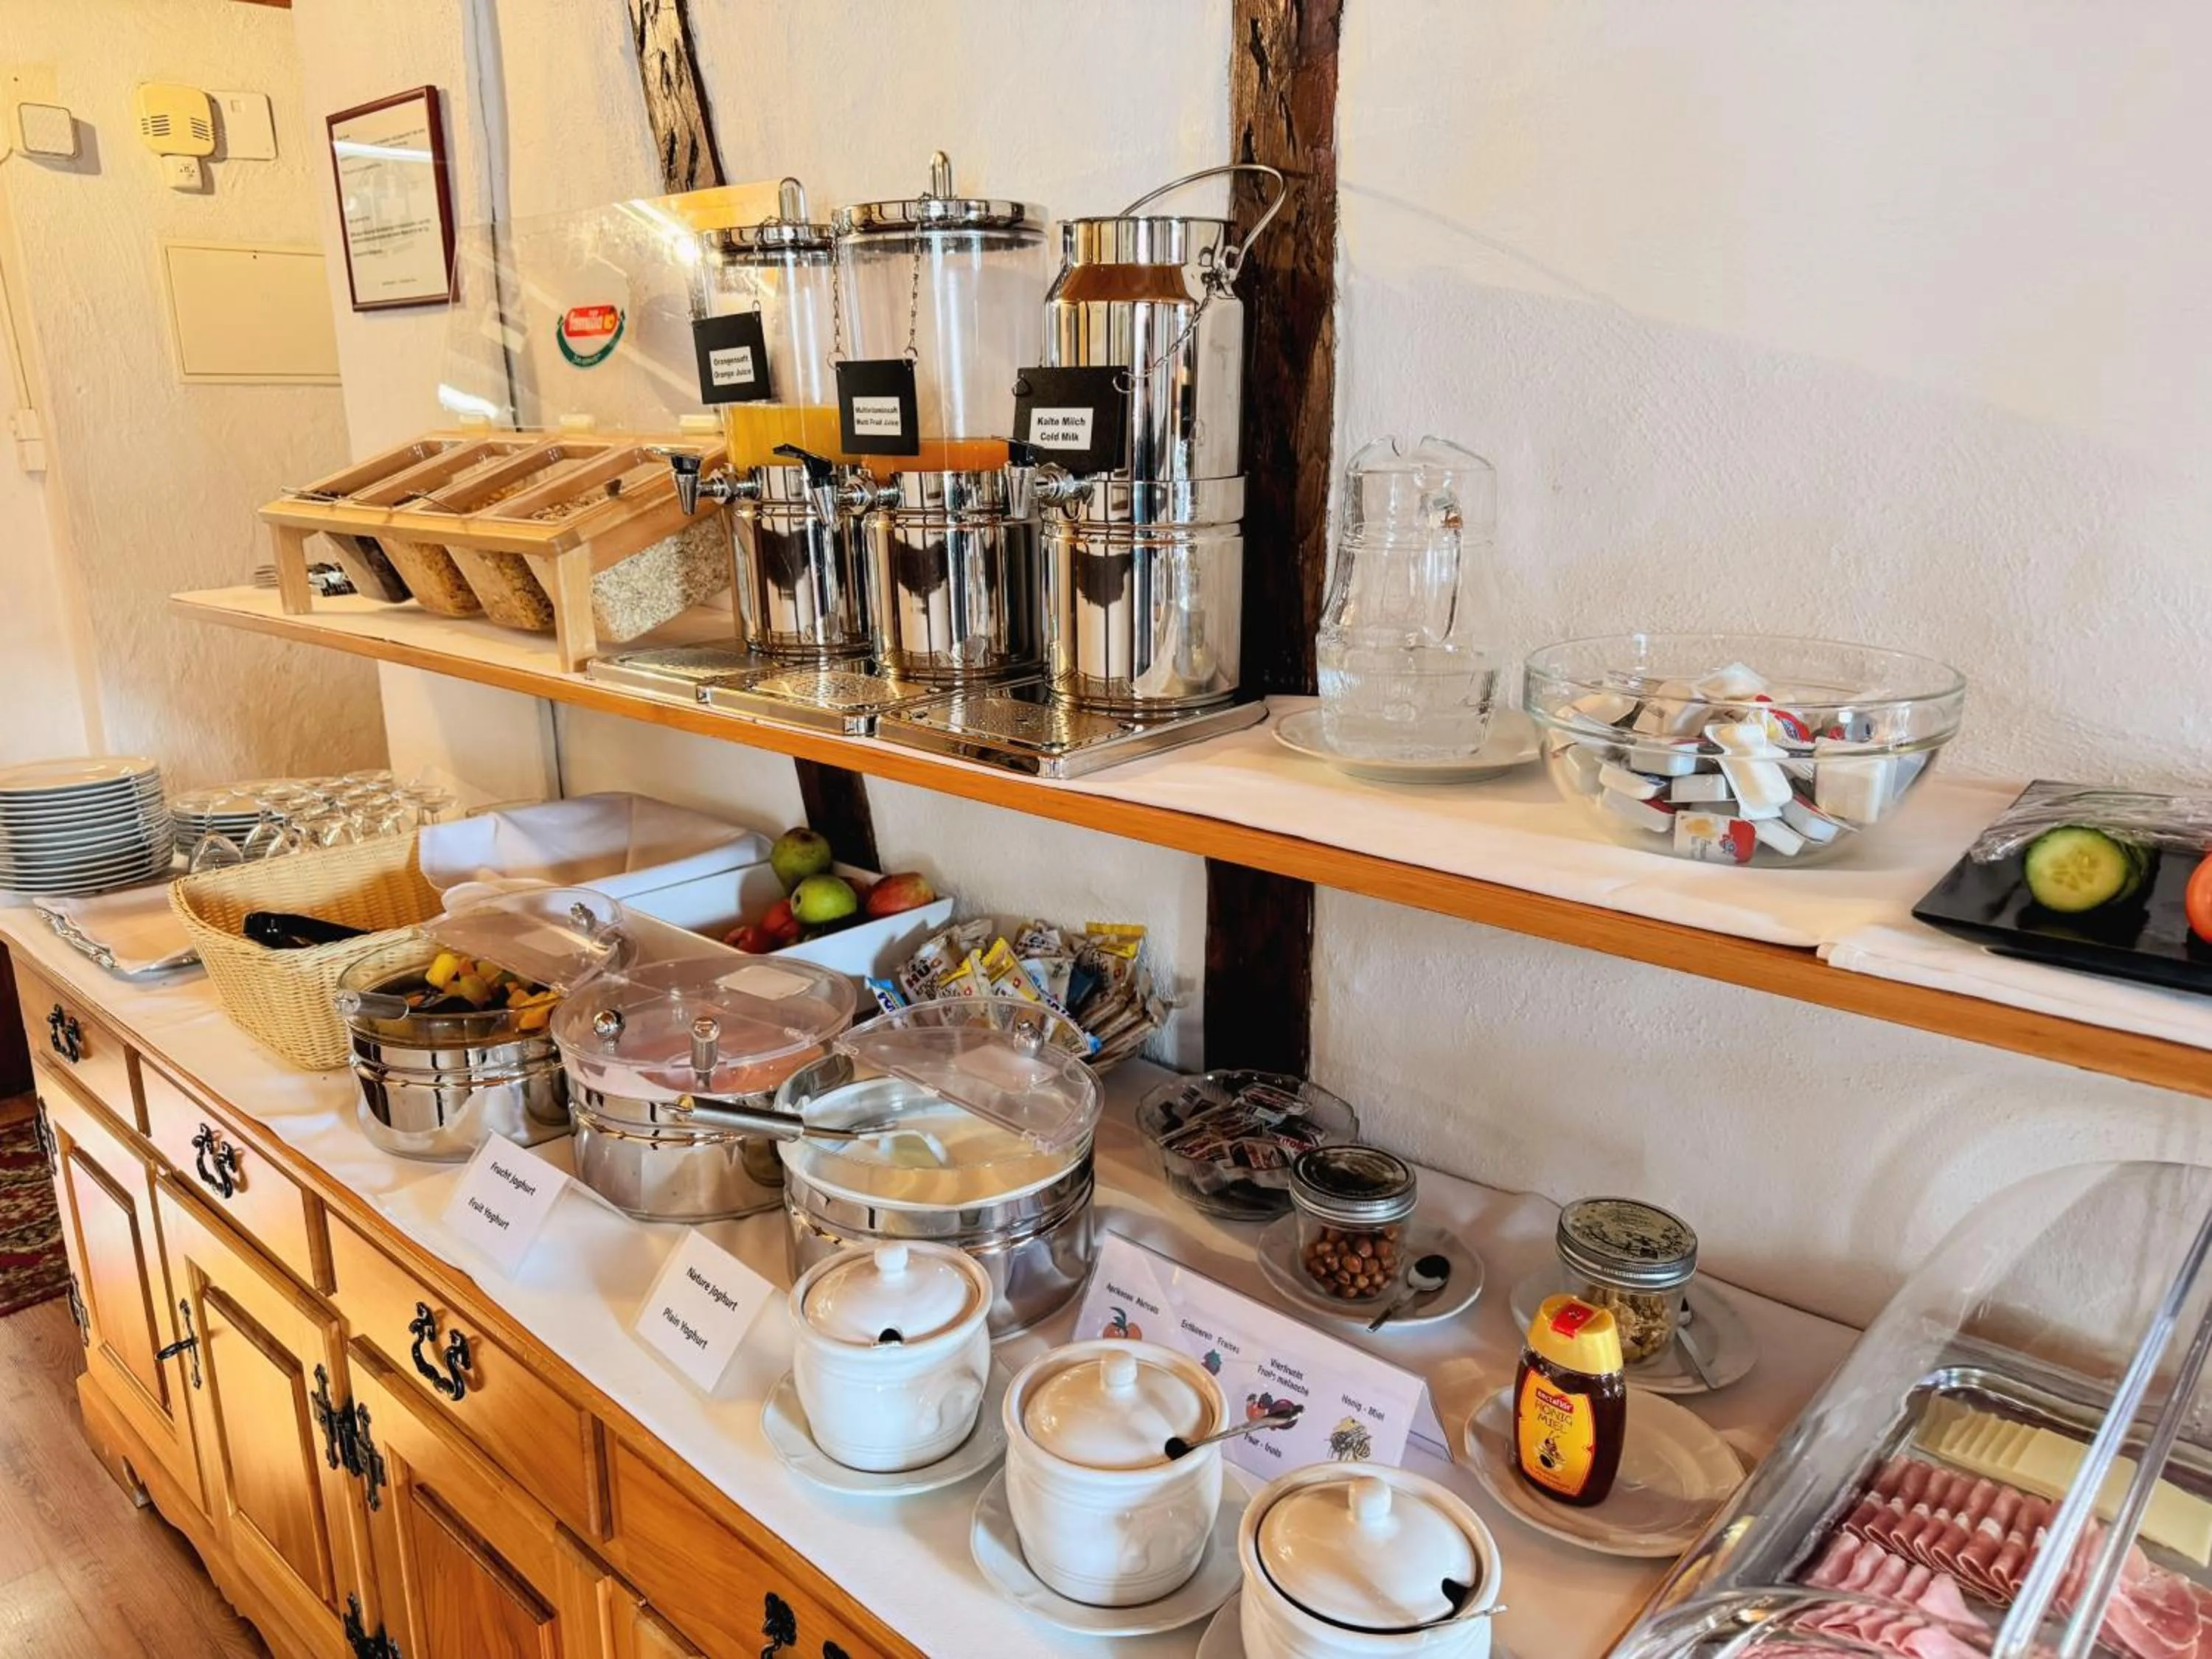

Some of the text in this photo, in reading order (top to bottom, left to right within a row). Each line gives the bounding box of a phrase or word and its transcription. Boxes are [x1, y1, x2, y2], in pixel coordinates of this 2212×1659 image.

[714, 371, 734, 379] Orange
[1037, 417, 1085, 425] Kalte Milch
[1040, 432, 1079, 441] Cold Milk
[490, 1161, 536, 1196] Frucht Joghurt
[468, 1197, 509, 1230] Fruit Yoghurt
[686, 1267, 738, 1312] Nature Joghurt
[663, 1307, 708, 1350] Plain Yoghurt
[1534, 1399, 1573, 1427] HONIG
[1537, 1412, 1567, 1435] MIEL
